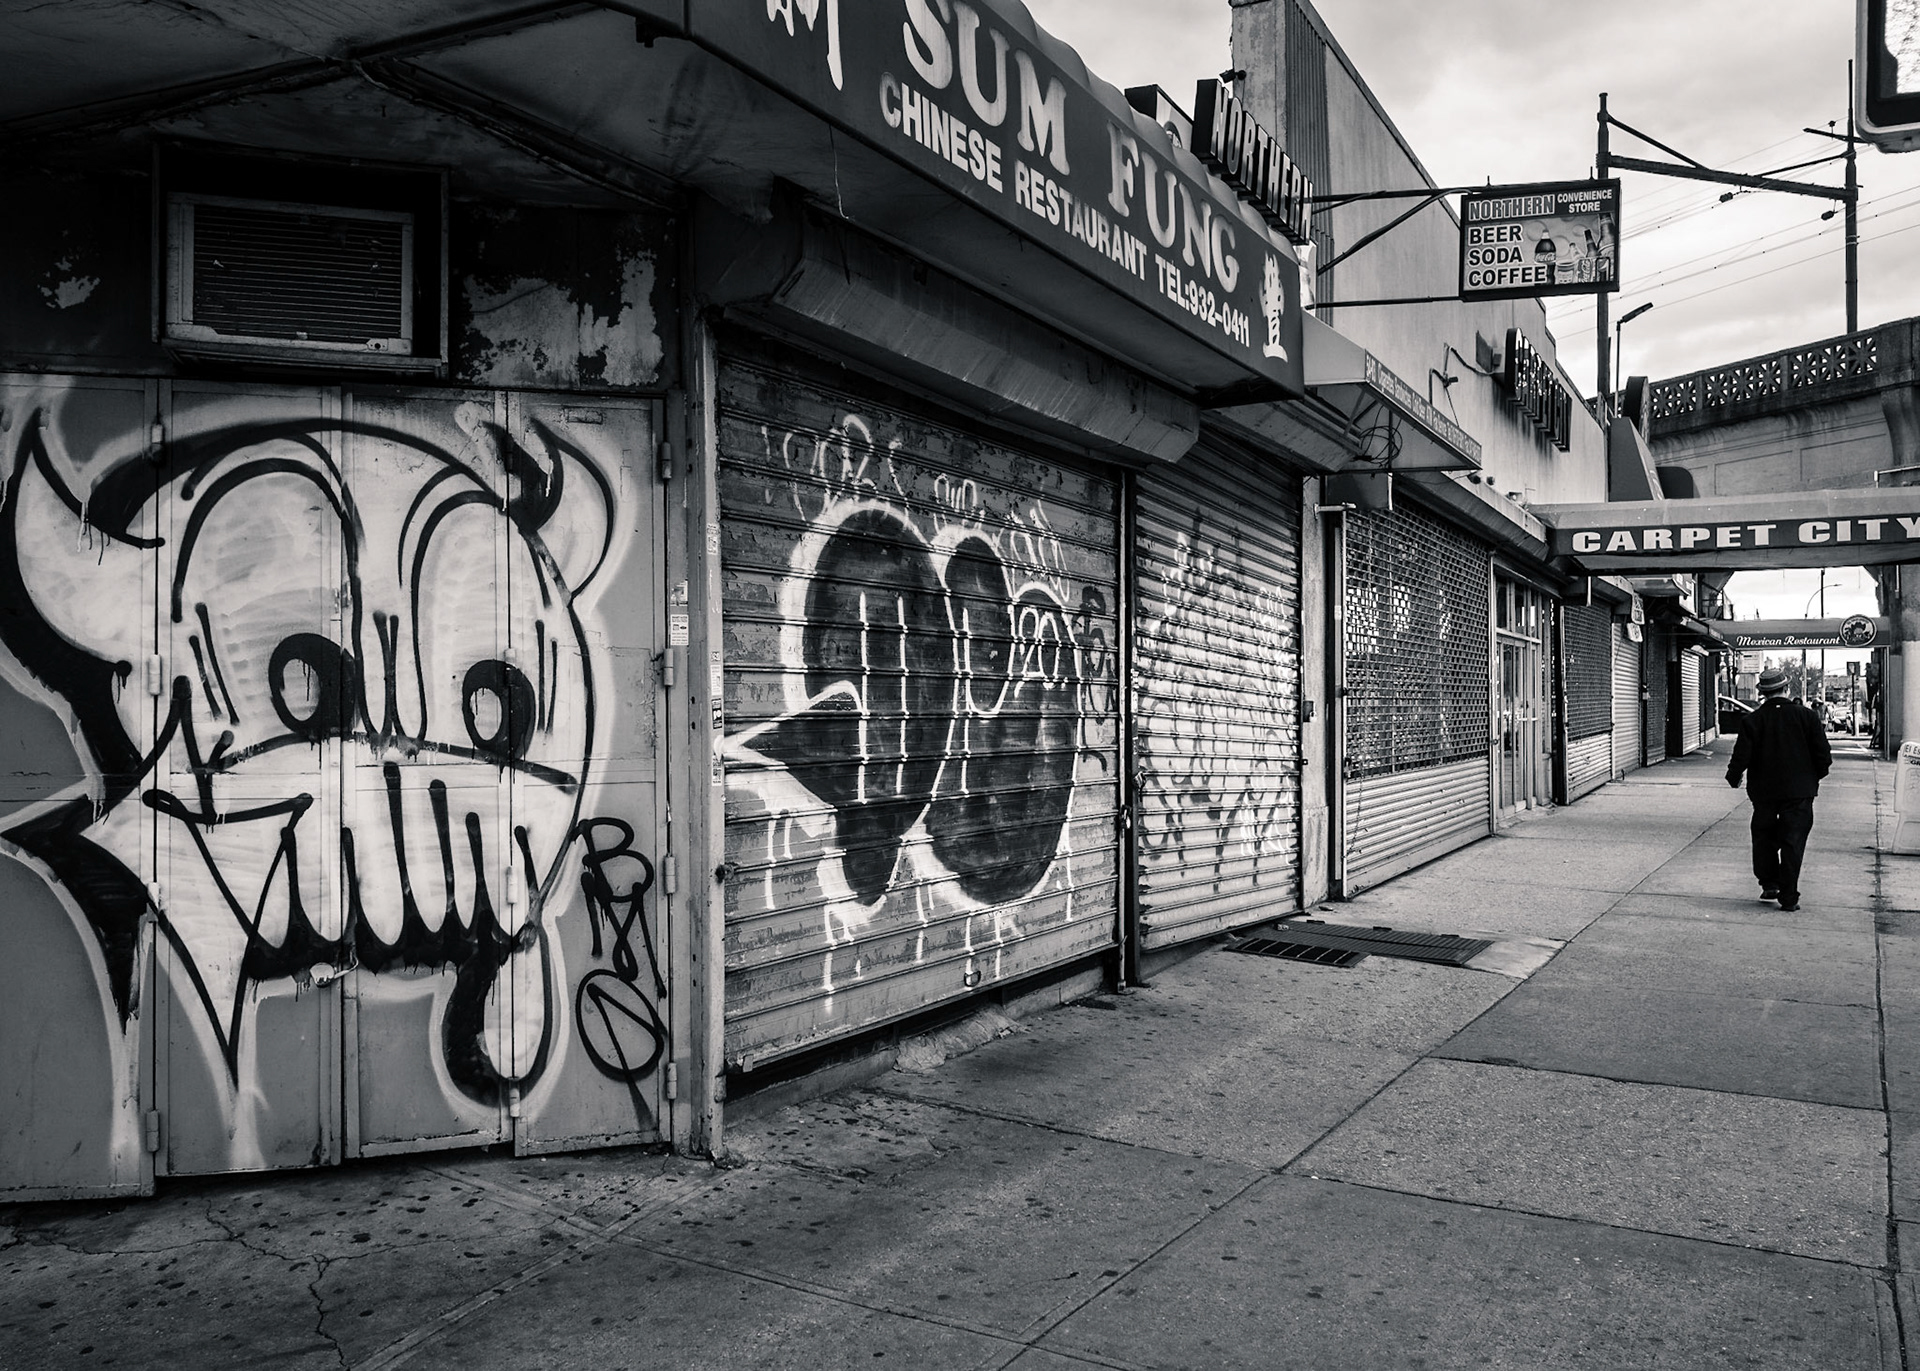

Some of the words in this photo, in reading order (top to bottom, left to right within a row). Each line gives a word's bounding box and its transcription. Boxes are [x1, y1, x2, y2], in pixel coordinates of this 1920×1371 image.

[903, 0, 1070, 176] SUM
[1107, 119, 1240, 293] FUNG
[1210, 79, 1313, 241] NORTHERN
[1468, 194, 1555, 221] NORTHERN
[1557, 189, 1613, 203] CONVENIENCE
[1568, 201, 1600, 213] STORE
[879, 71, 1003, 193] CHINESE
[1015, 158, 1147, 281] RESTAURANT
[1155, 252, 1250, 348] TEL:932-0411
[1468, 224, 1523, 245] BEER
[1468, 246, 1523, 266] SODA
[1468, 264, 1548, 287] COFFEE
[1572, 524, 1777, 553] CARPET
[1798, 517, 1920, 543] CITY
[1736, 635, 1782, 646] Mexican
[1783, 635, 1840, 646] Restaurant
